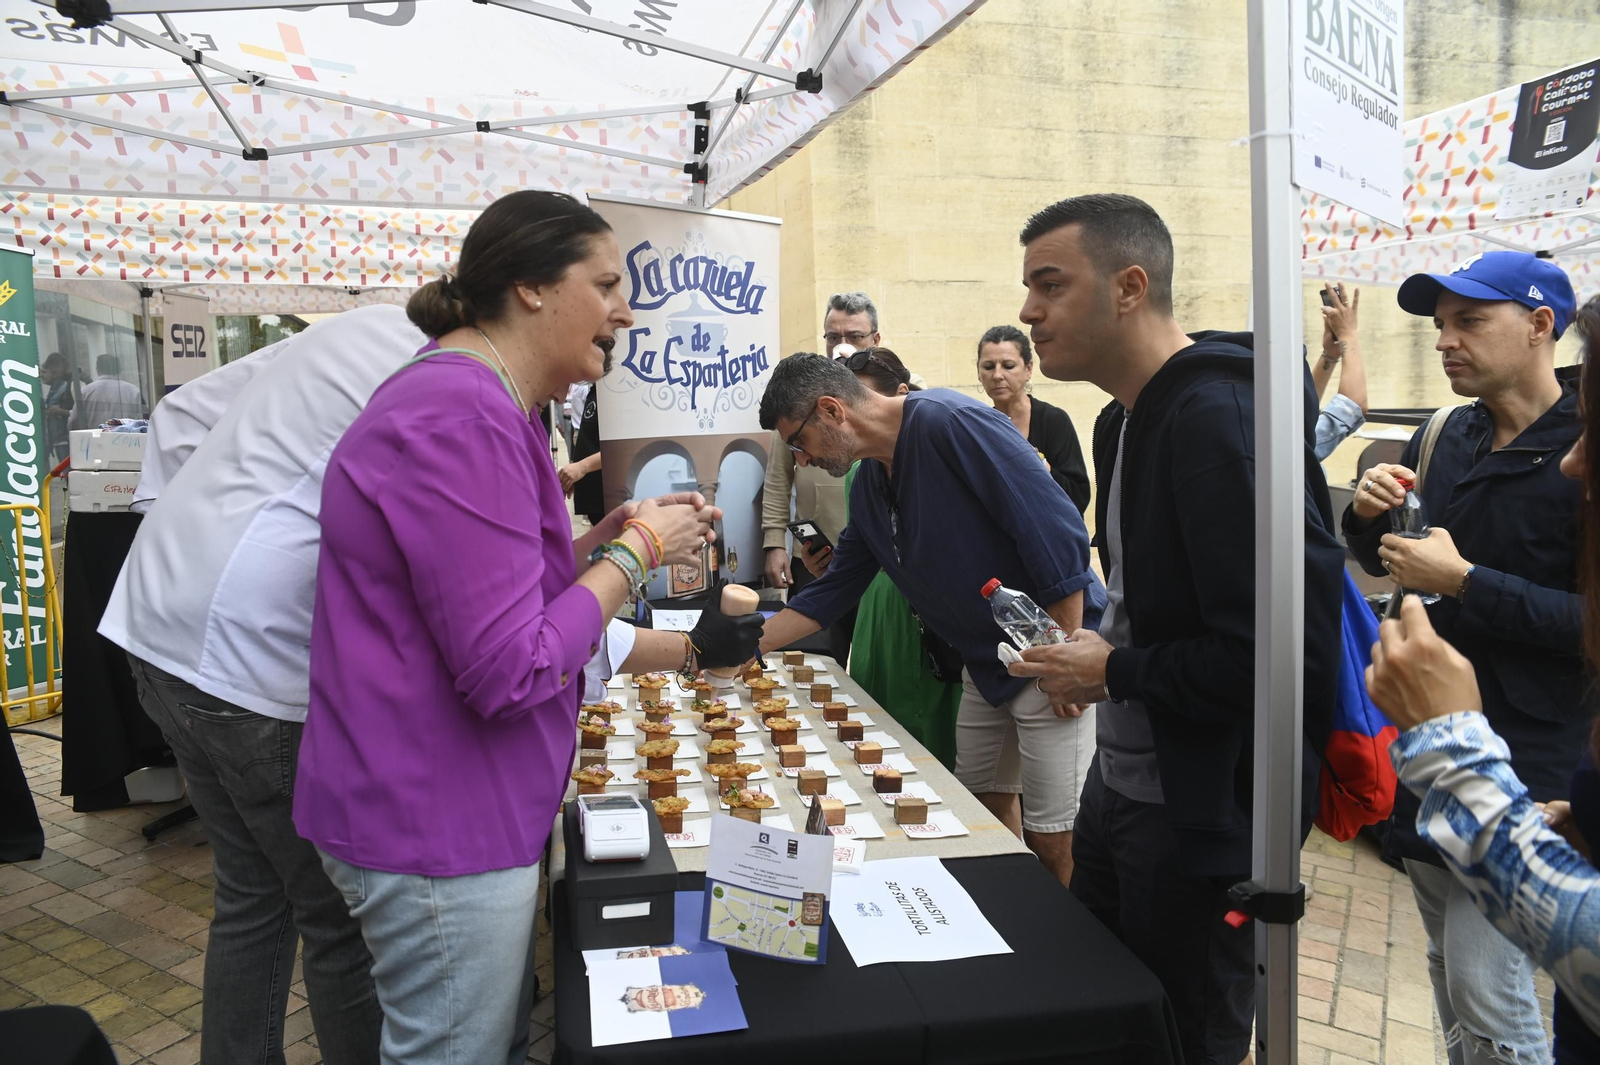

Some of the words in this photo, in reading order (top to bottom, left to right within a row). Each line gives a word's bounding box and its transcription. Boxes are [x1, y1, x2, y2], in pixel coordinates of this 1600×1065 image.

[1305, 0, 1398, 97] BAENA
[1304, 56, 1348, 104] Consejo
[1350, 83, 1399, 131] Regulador
[626, 240, 678, 311] La
[170, 323, 207, 358] SER
[621, 326, 666, 384] La
[691, 322, 711, 352] de
[885, 881, 901, 891] DE
[912, 887, 950, 926] ALISTADOS
[892, 891, 931, 936] TORTILLITAS
